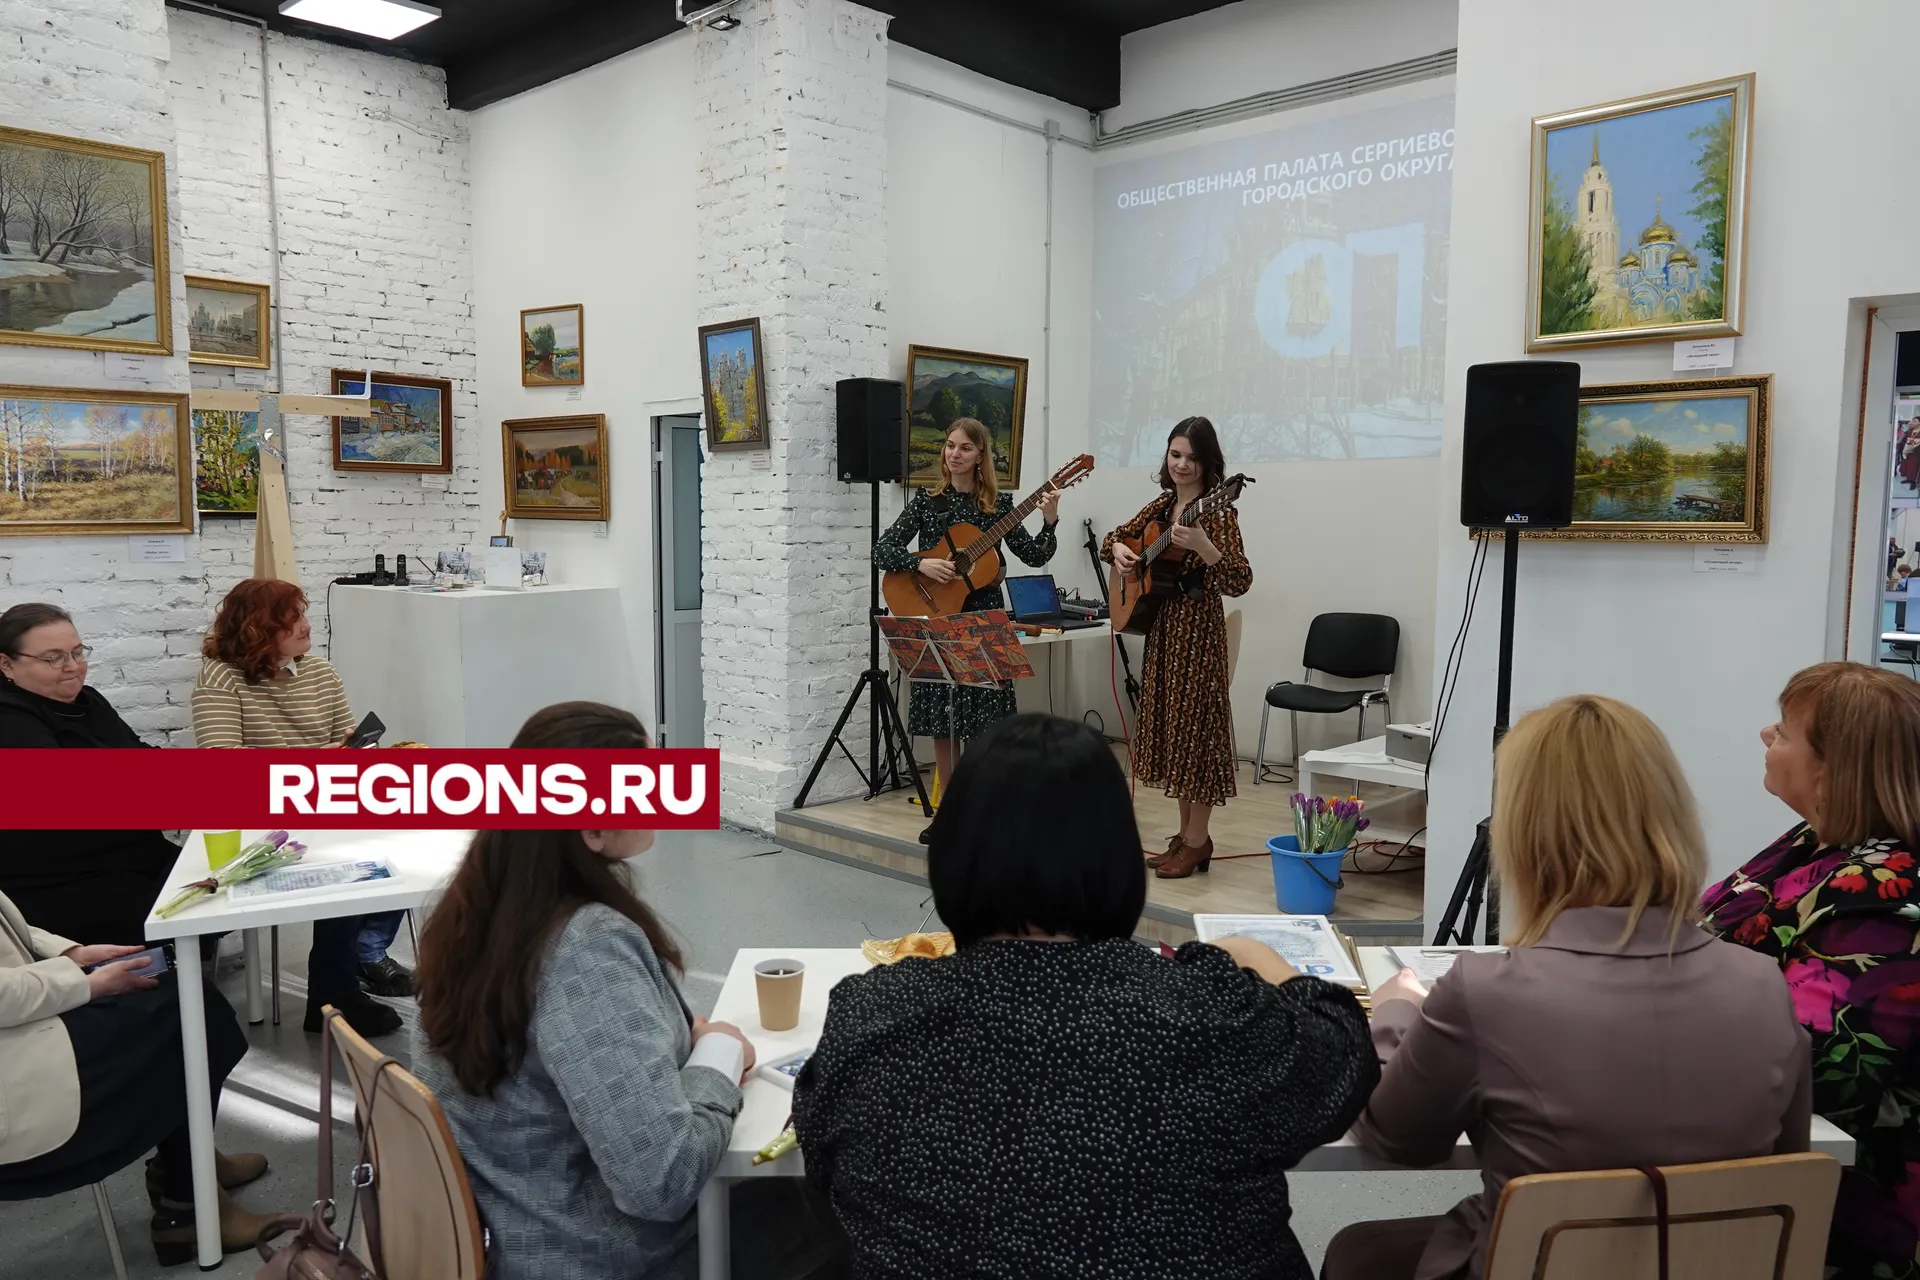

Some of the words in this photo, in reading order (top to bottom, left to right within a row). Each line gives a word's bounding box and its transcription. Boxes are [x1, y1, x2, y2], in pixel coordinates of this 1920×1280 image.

[1117, 167, 1257, 209] ОБЩЕСТВЕННАЯ
[1264, 151, 1344, 182] ПАЛАТА
[1351, 128, 1455, 165] СЕРГИЕВО
[1242, 167, 1373, 207] ГОРОДСКОГО
